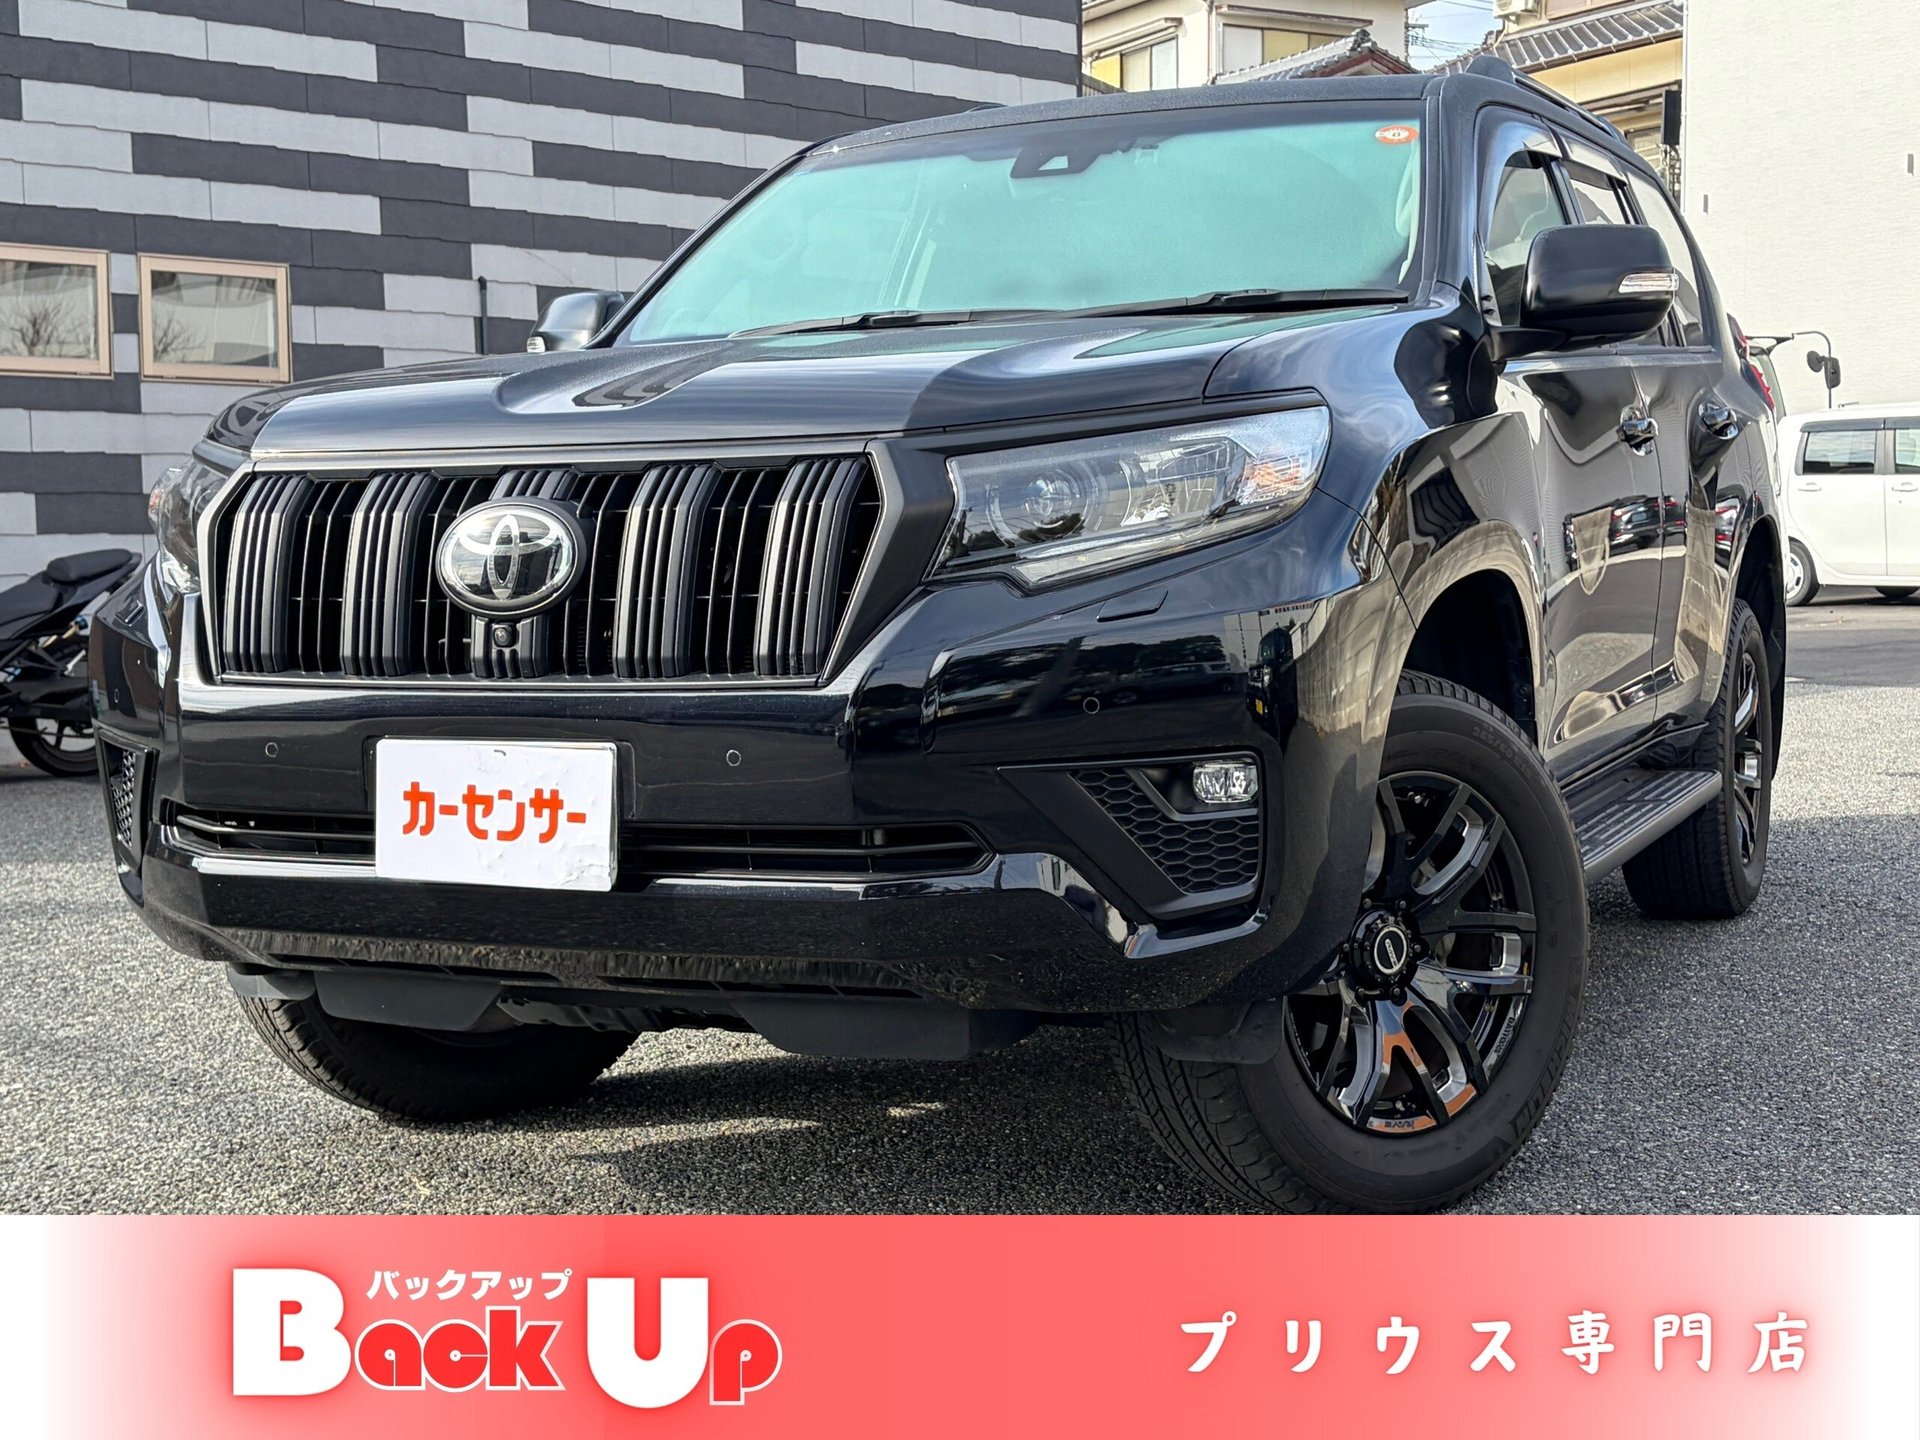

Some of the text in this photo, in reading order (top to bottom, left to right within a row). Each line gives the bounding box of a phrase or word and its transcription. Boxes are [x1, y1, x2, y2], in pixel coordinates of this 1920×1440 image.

[402, 781, 586, 844] カーセンサー
